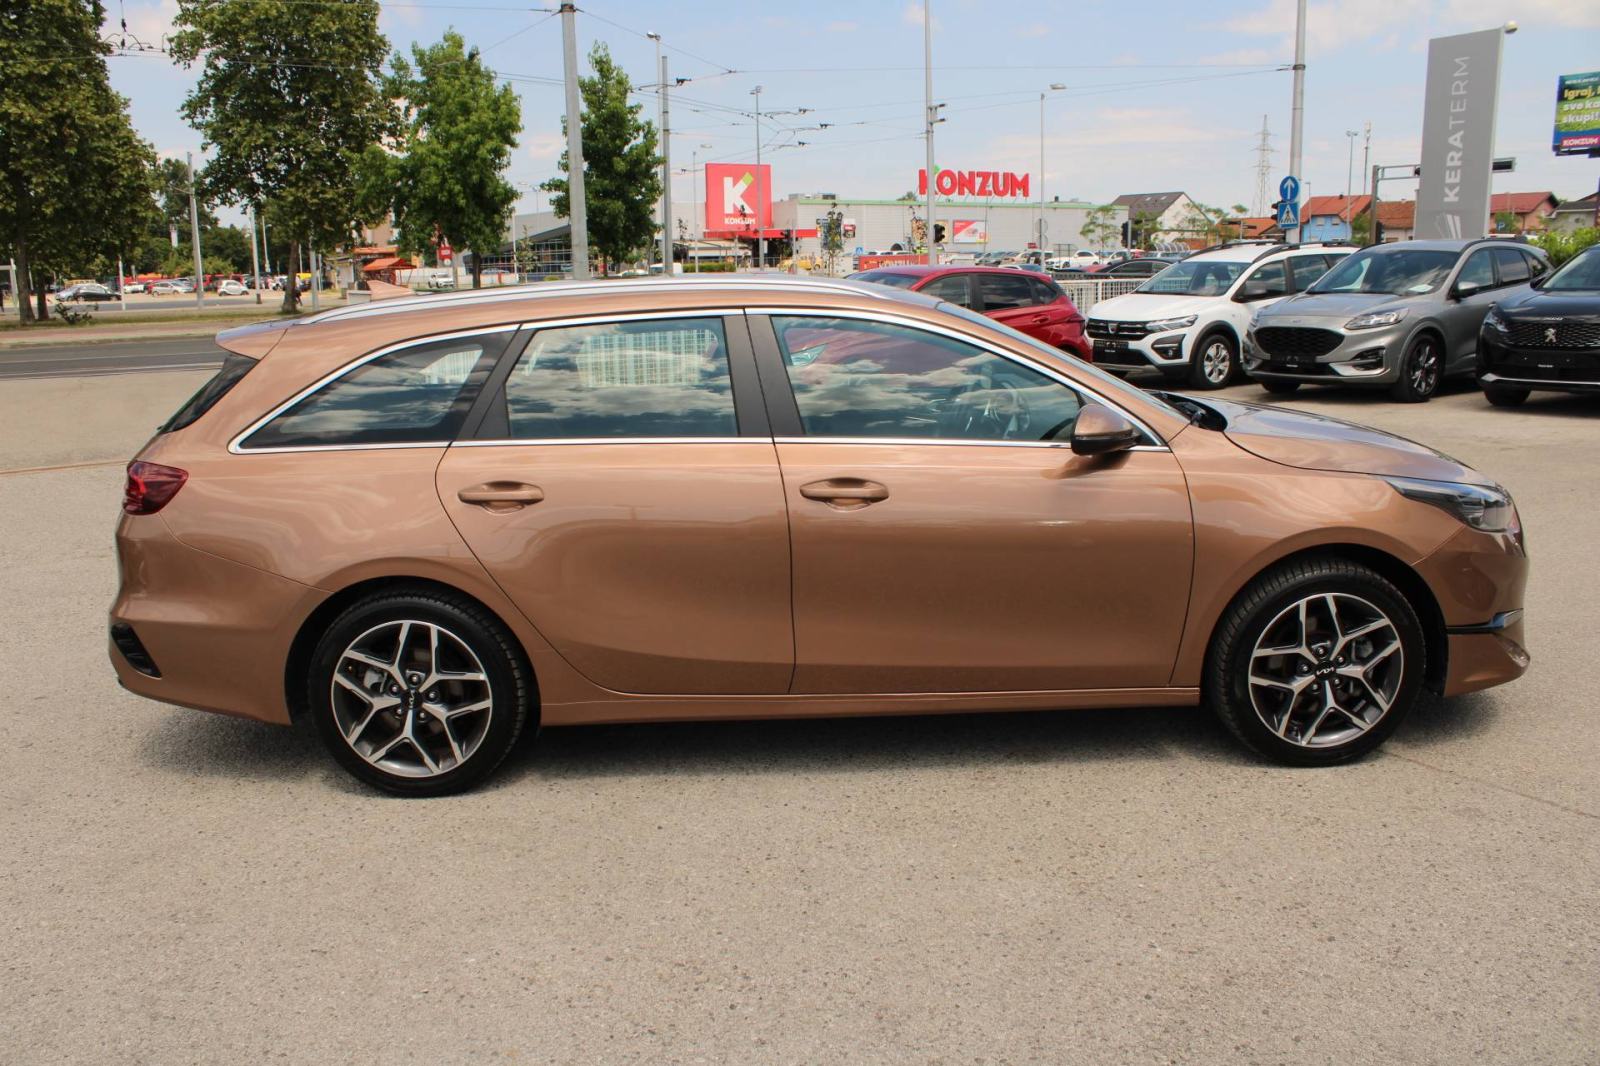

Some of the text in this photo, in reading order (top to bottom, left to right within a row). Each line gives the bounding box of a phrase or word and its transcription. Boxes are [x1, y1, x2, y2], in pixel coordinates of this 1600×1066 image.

[1564, 86, 1596, 101] Igraj,
[1443, 56, 1470, 202] KERATERM
[1563, 138, 1598, 147] KONZUM
[723, 172, 754, 215] K
